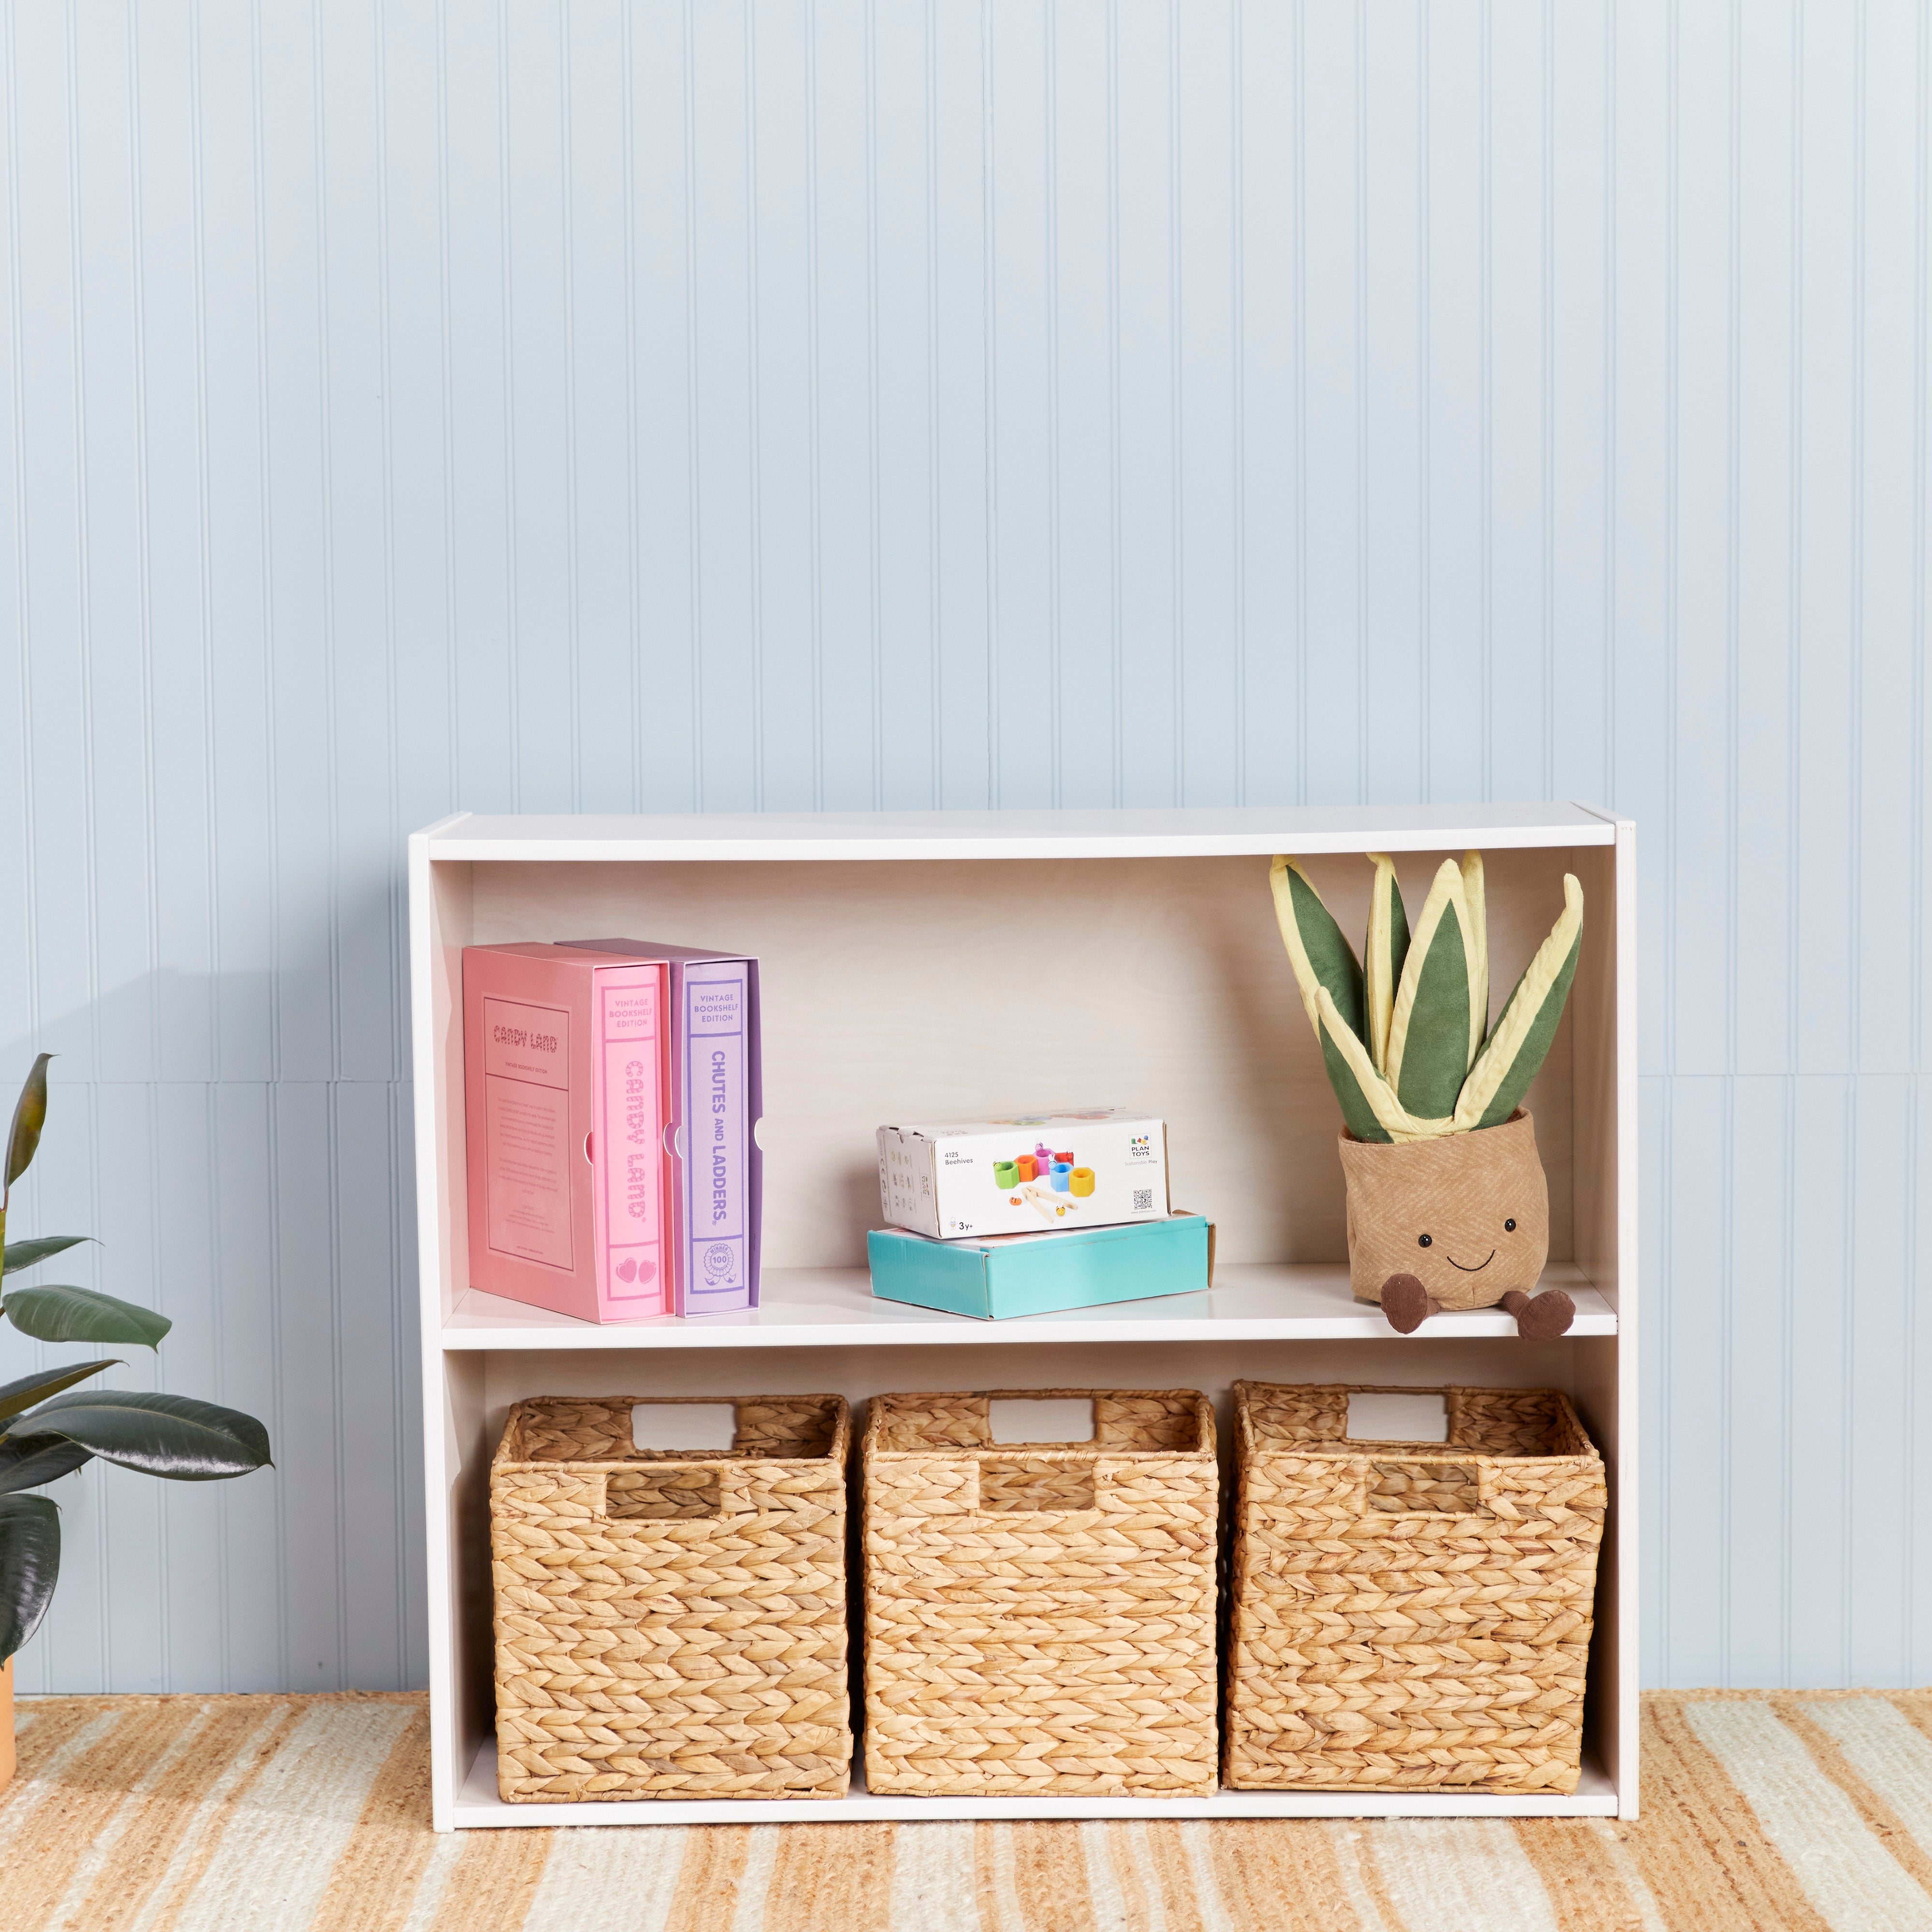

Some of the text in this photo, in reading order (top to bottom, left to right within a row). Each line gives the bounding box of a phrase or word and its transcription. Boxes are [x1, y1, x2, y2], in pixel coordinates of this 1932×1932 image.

[615, 998, 648, 1007] VINTAGE
[700, 994, 734, 1002] VINTAGE
[695, 1004, 738, 1012] BOOKSHELF
[609, 1008, 652, 1018] BOOKSHELF
[617, 1019, 647, 1027] EDITION
[494, 1025, 527, 1047] CANDY
[711, 1051, 725, 1114] CHUTES
[625, 1061, 645, 1144] CANDY
[714, 1118, 724, 1141] AND
[710, 1245, 728, 1253] WINNER
